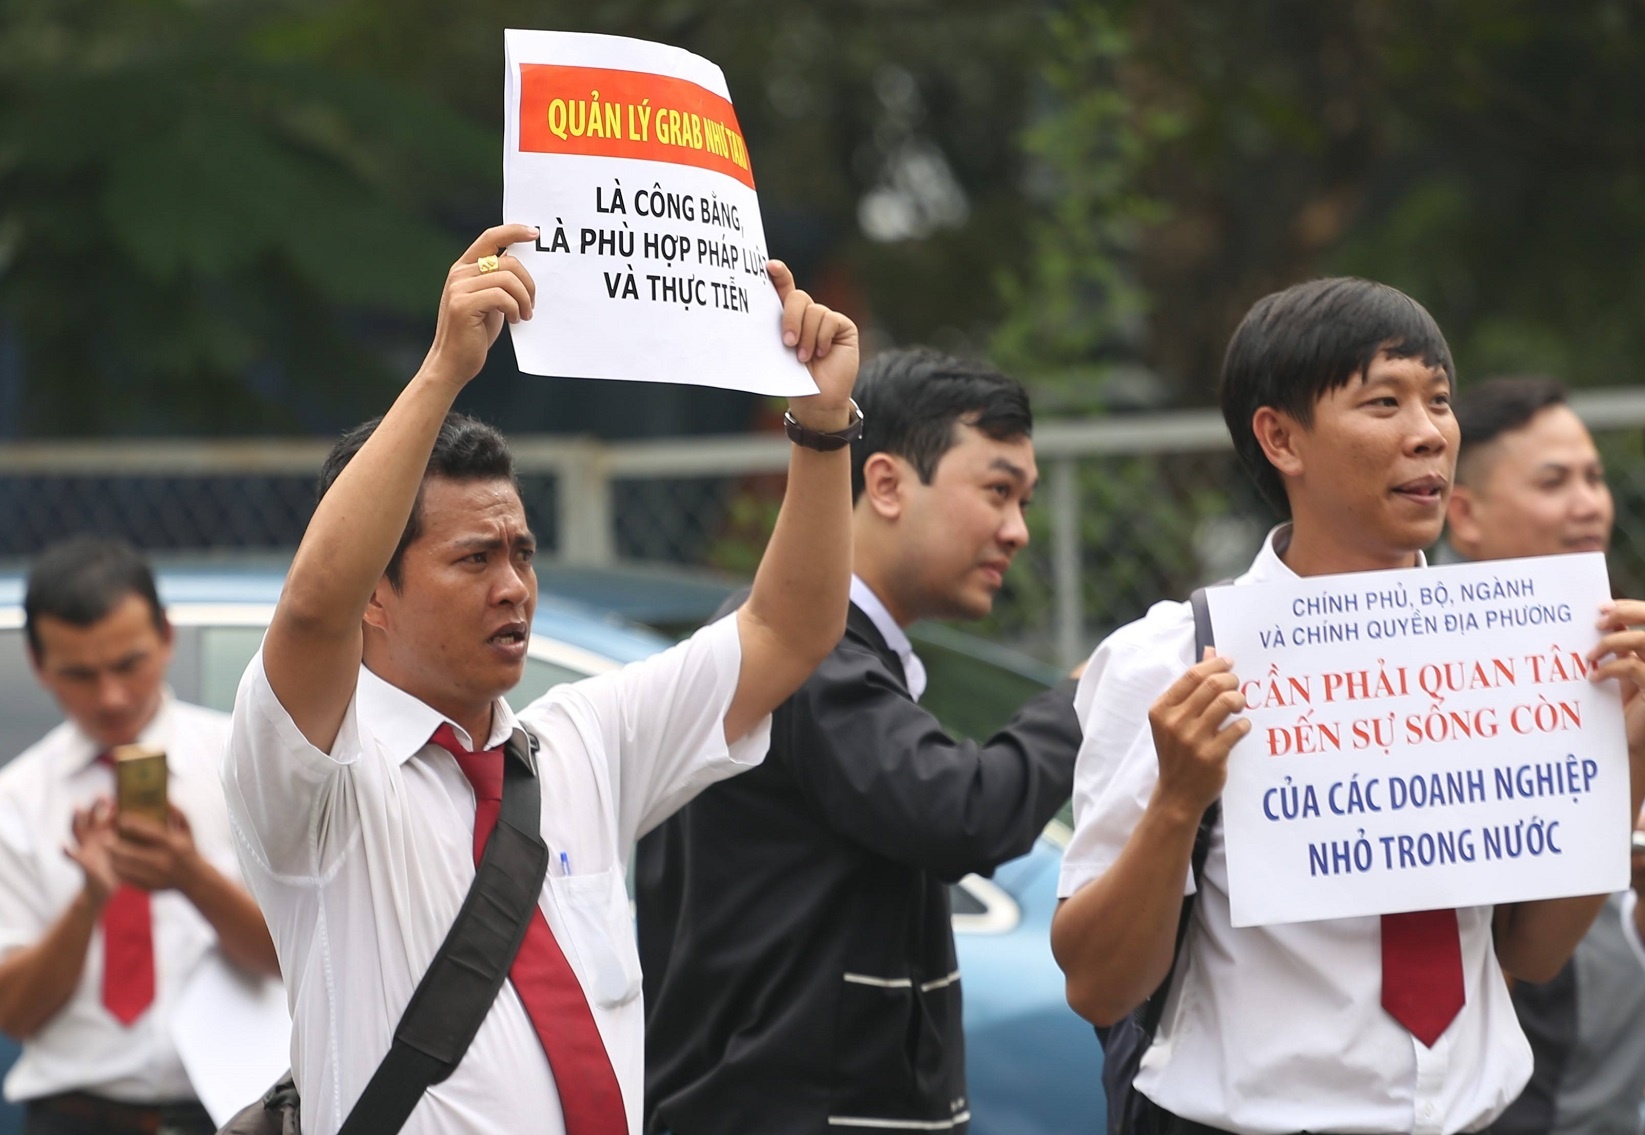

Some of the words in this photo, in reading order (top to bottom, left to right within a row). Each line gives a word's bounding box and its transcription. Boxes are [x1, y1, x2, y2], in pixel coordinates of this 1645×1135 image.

[547, 90, 622, 141] QUẢN
[628, 98, 652, 142] LÝ
[655, 108, 703, 150] GRAB
[702, 116, 729, 159] NHƯ
[596, 178, 627, 215] LÀ
[634, 182, 695, 221] CÔNG
[700, 190, 744, 238] BẰNG,
[535, 216, 570, 253] LÀ
[580, 221, 635, 257] PHÙ
[644, 231, 691, 267] HỢP
[697, 234, 738, 270] PHÁP
[742, 245, 767, 285] LUẬ
[603, 264, 639, 300] VÀ
[646, 273, 706, 311] THỰC
[711, 276, 749, 314] TIỄN
[1259, 622, 1286, 650] VÀ
[1292, 617, 1359, 647] CHÍNH
[1367, 609, 1438, 639] QUYỀN
[1444, 612, 1479, 637] ĐỊA
[1486, 605, 1572, 631] PHƯƠNG
[1292, 588, 1358, 618] CHÍNH
[1366, 582, 1413, 611] PHỦ,
[1421, 585, 1454, 607] BỘ,
[1461, 577, 1535, 601] NGÀNH
[1240, 663, 1311, 711] CẦN
[1321, 658, 1410, 703] PHẢI
[1419, 657, 1516, 698] QUAN
[1266, 708, 1341, 757] ĐẾN
[1352, 711, 1395, 755] SỰ
[1405, 696, 1500, 745] SỐNG
[1510, 693, 1582, 734] CÒN
[1262, 775, 1321, 822] CỦA
[1328, 773, 1381, 815] CÁC
[1389, 769, 1486, 810] DOANH
[1494, 753, 1598, 804] NGHIỆP
[1308, 828, 1373, 877] NHỎ
[1379, 828, 1476, 870] TRONG
[1483, 815, 1563, 862] NƯỚC
